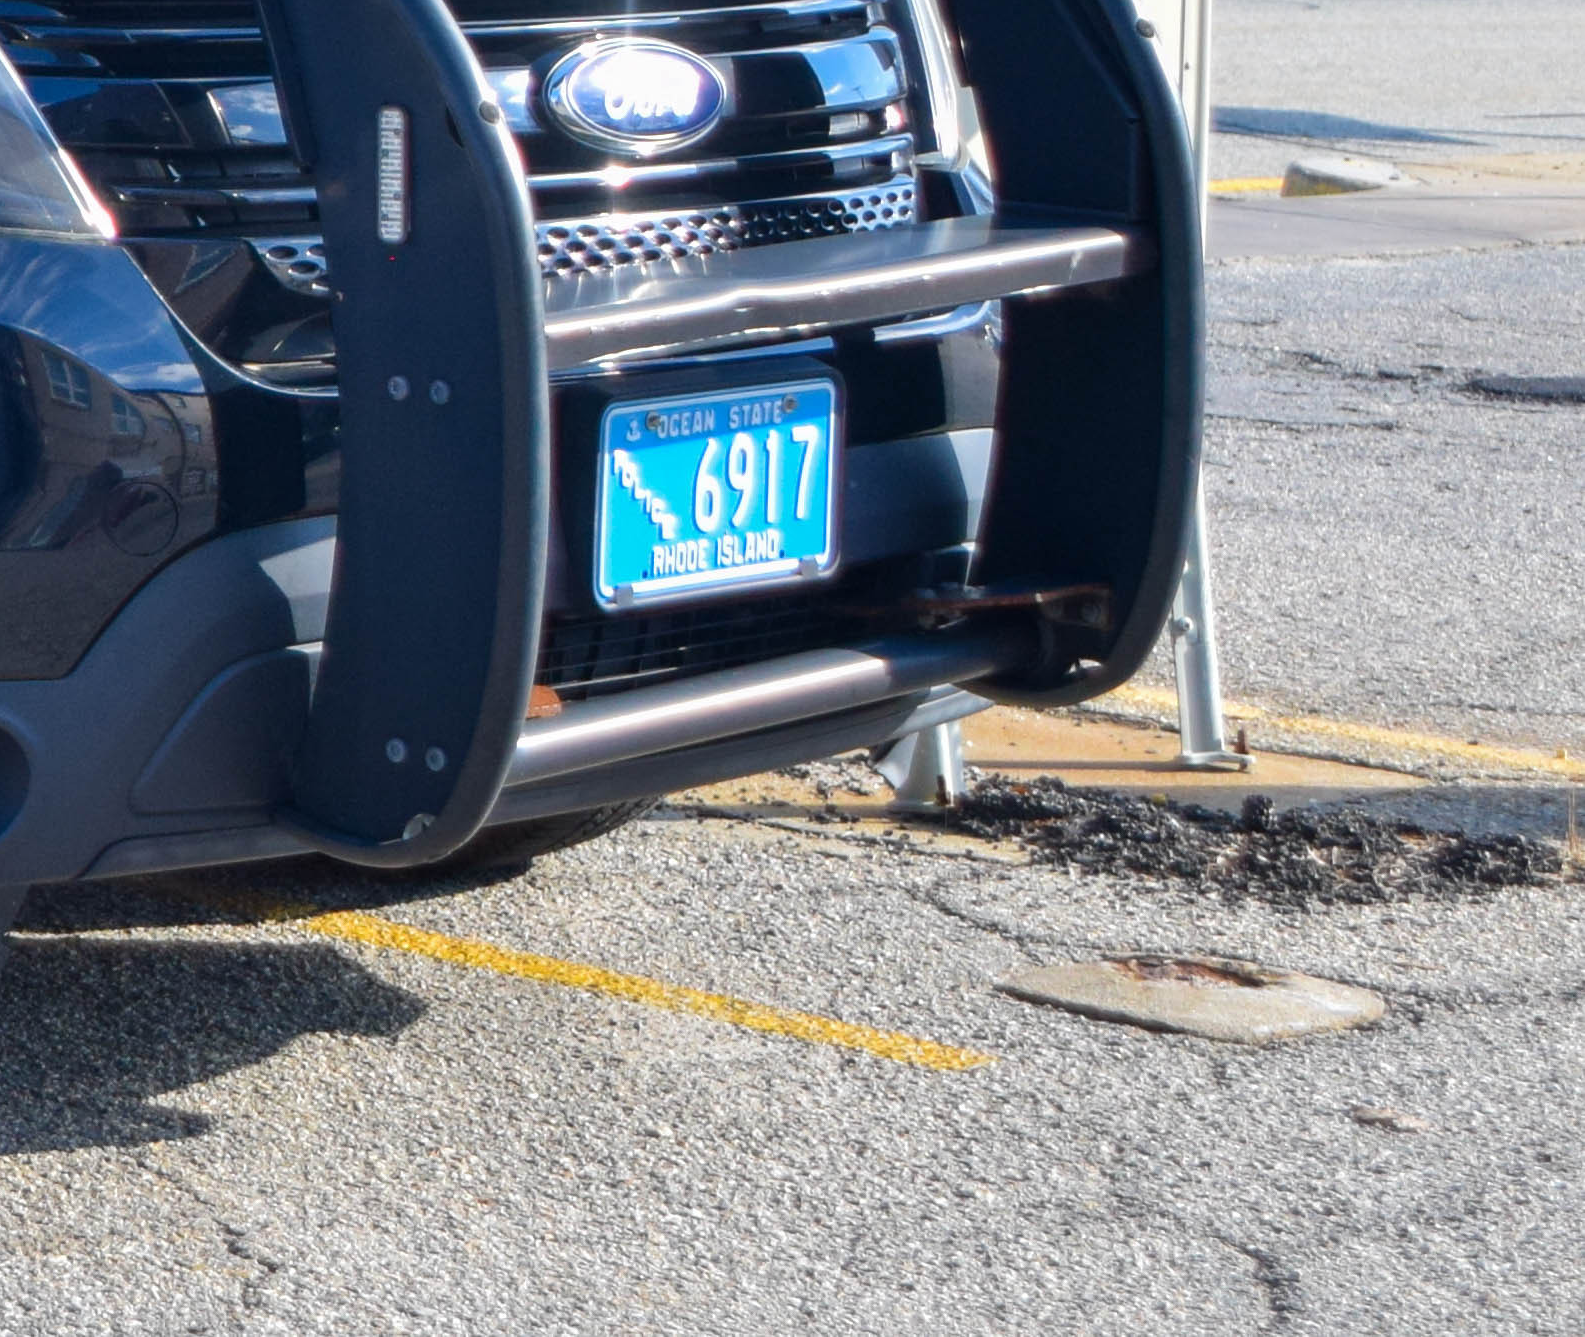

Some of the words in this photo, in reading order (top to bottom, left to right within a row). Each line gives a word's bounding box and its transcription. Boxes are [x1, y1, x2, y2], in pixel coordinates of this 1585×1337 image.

[656, 410, 715, 439] OCEAN
[728, 400, 783, 430] STATE
[612, 448, 678, 540] POLICE
[693, 424, 819, 534] 6917
[652, 538, 708, 577] RHODE
[717, 528, 780, 567] ISLAND
